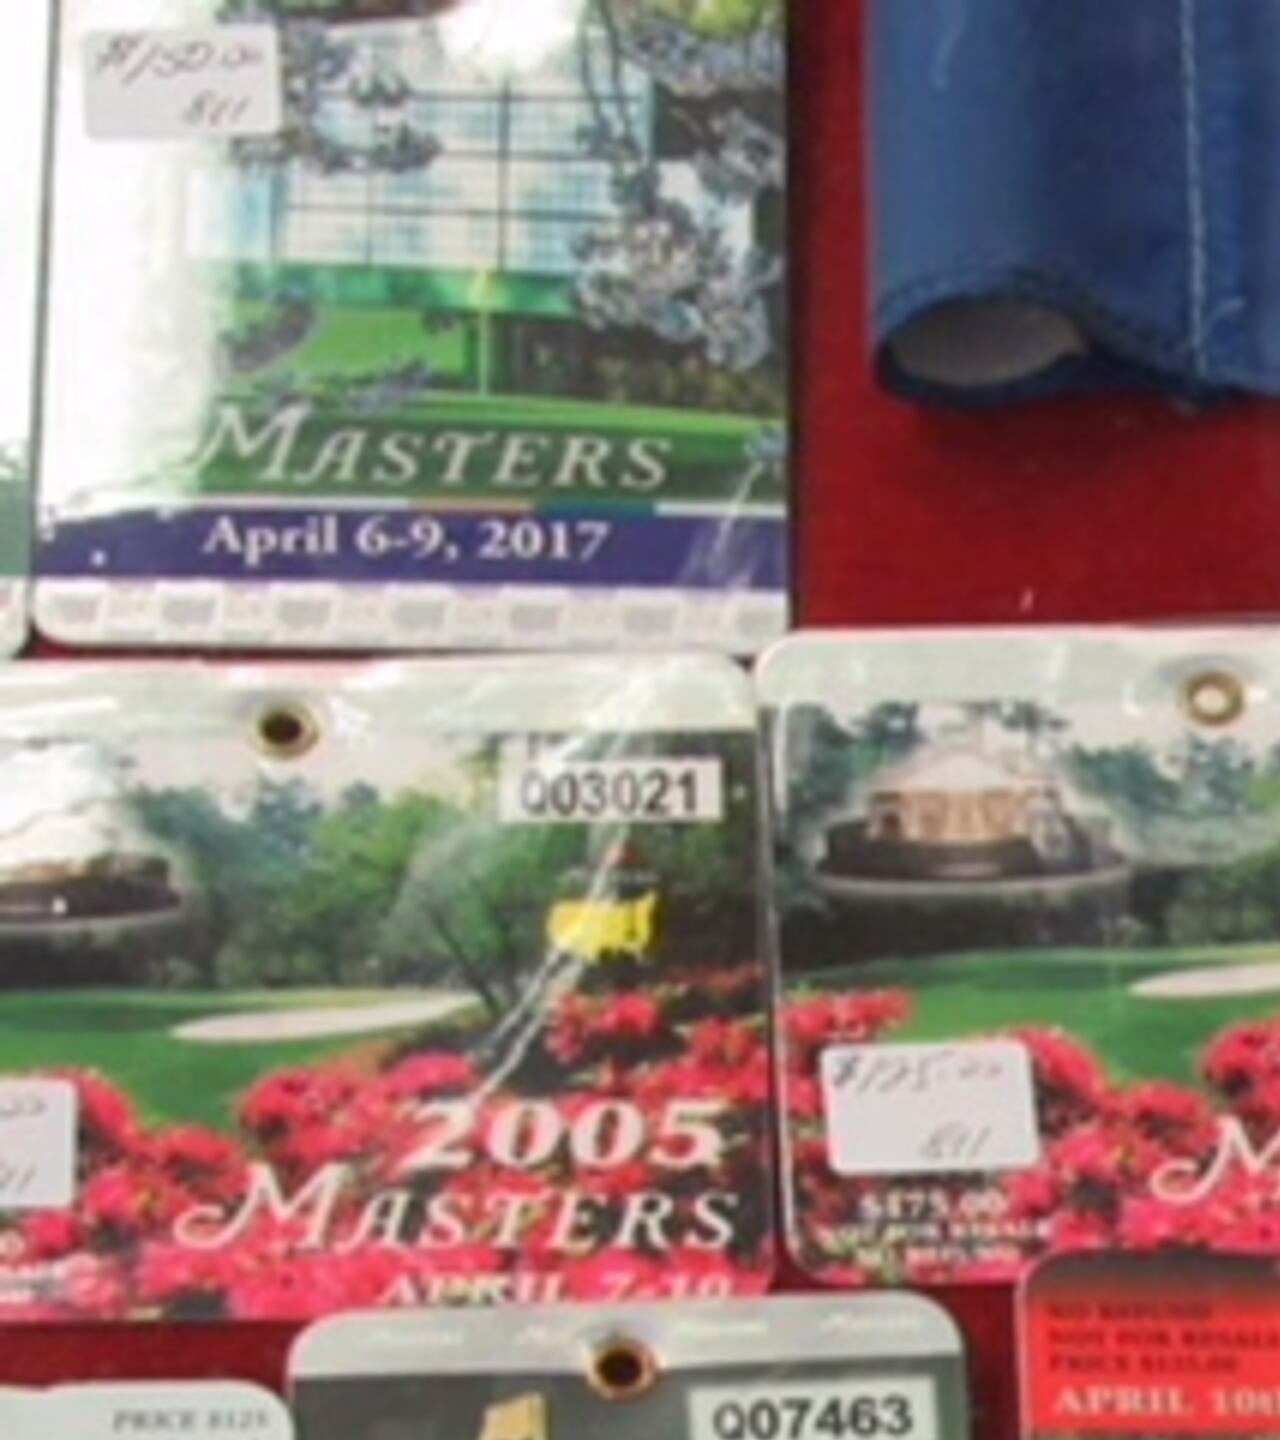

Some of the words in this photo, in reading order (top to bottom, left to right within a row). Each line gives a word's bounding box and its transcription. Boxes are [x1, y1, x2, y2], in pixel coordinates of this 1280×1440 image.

[190, 402, 674, 490] MASTERS
[203, 519, 341, 566] April
[356, 521, 459, 562] 6-9,
[478, 521, 609, 559] 2017
[520, 769, 699, 816] Q03021
[403, 1102, 729, 1170] 2005
[173, 1161, 738, 1252] MASTERS
[378, 1272, 568, 1303] APRIL
[1053, 1383, 1194, 1417] APRIL
